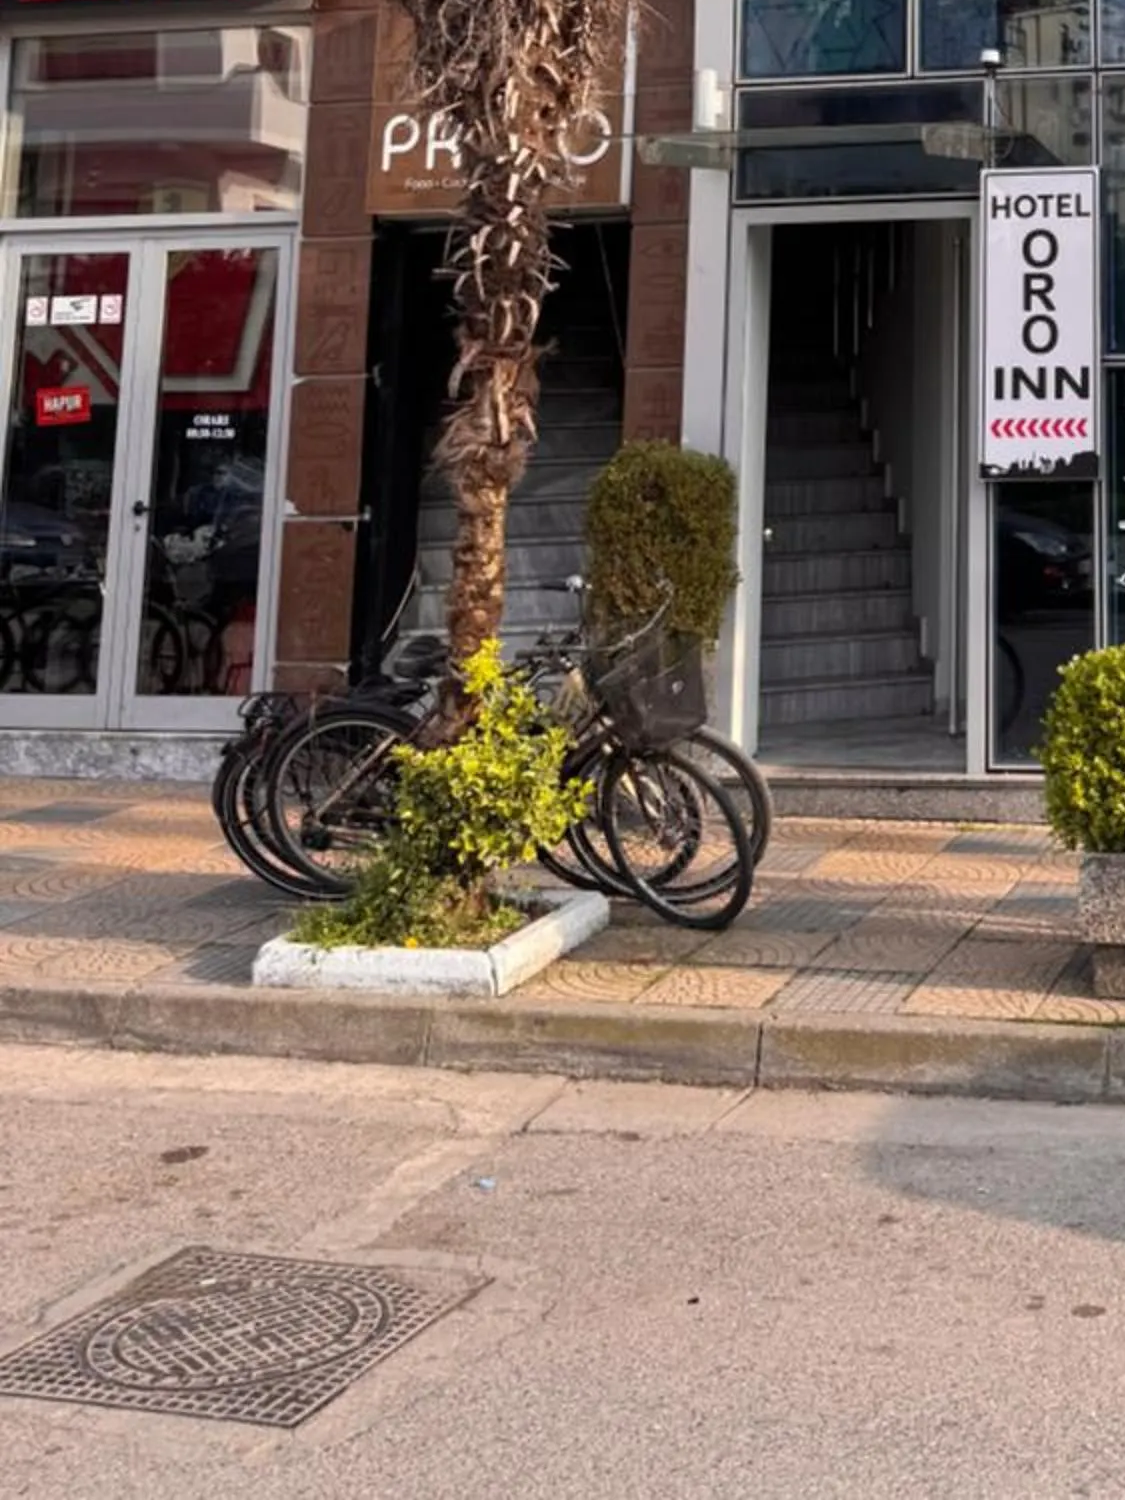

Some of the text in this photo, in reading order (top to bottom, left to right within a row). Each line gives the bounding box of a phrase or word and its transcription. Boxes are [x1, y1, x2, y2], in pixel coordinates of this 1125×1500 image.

[991, 193, 1091, 219] HOTEL
[1021, 228, 1060, 354] ORO
[993, 366, 1090, 400] INN
